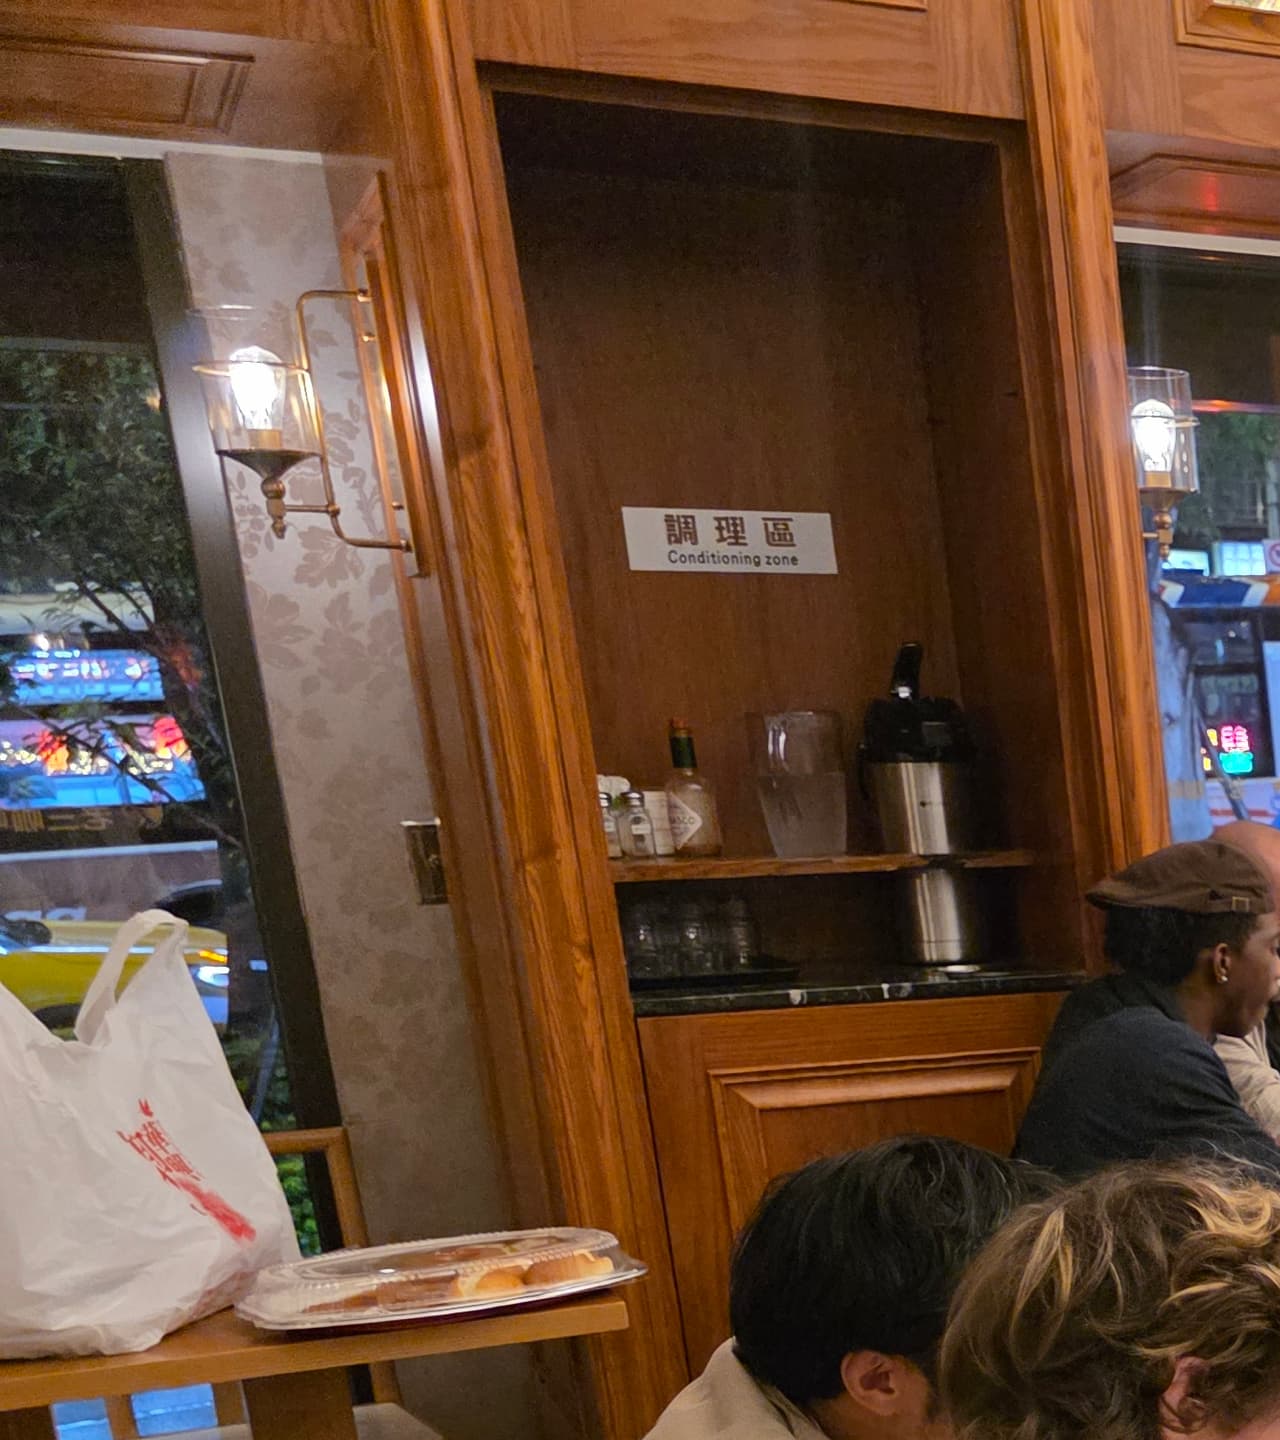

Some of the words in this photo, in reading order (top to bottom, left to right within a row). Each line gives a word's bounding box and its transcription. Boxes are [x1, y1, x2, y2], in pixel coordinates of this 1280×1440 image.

[664, 514, 797, 547] 調理區
[668, 549, 762, 567] Conditioning
[764, 555, 799, 566] zone
